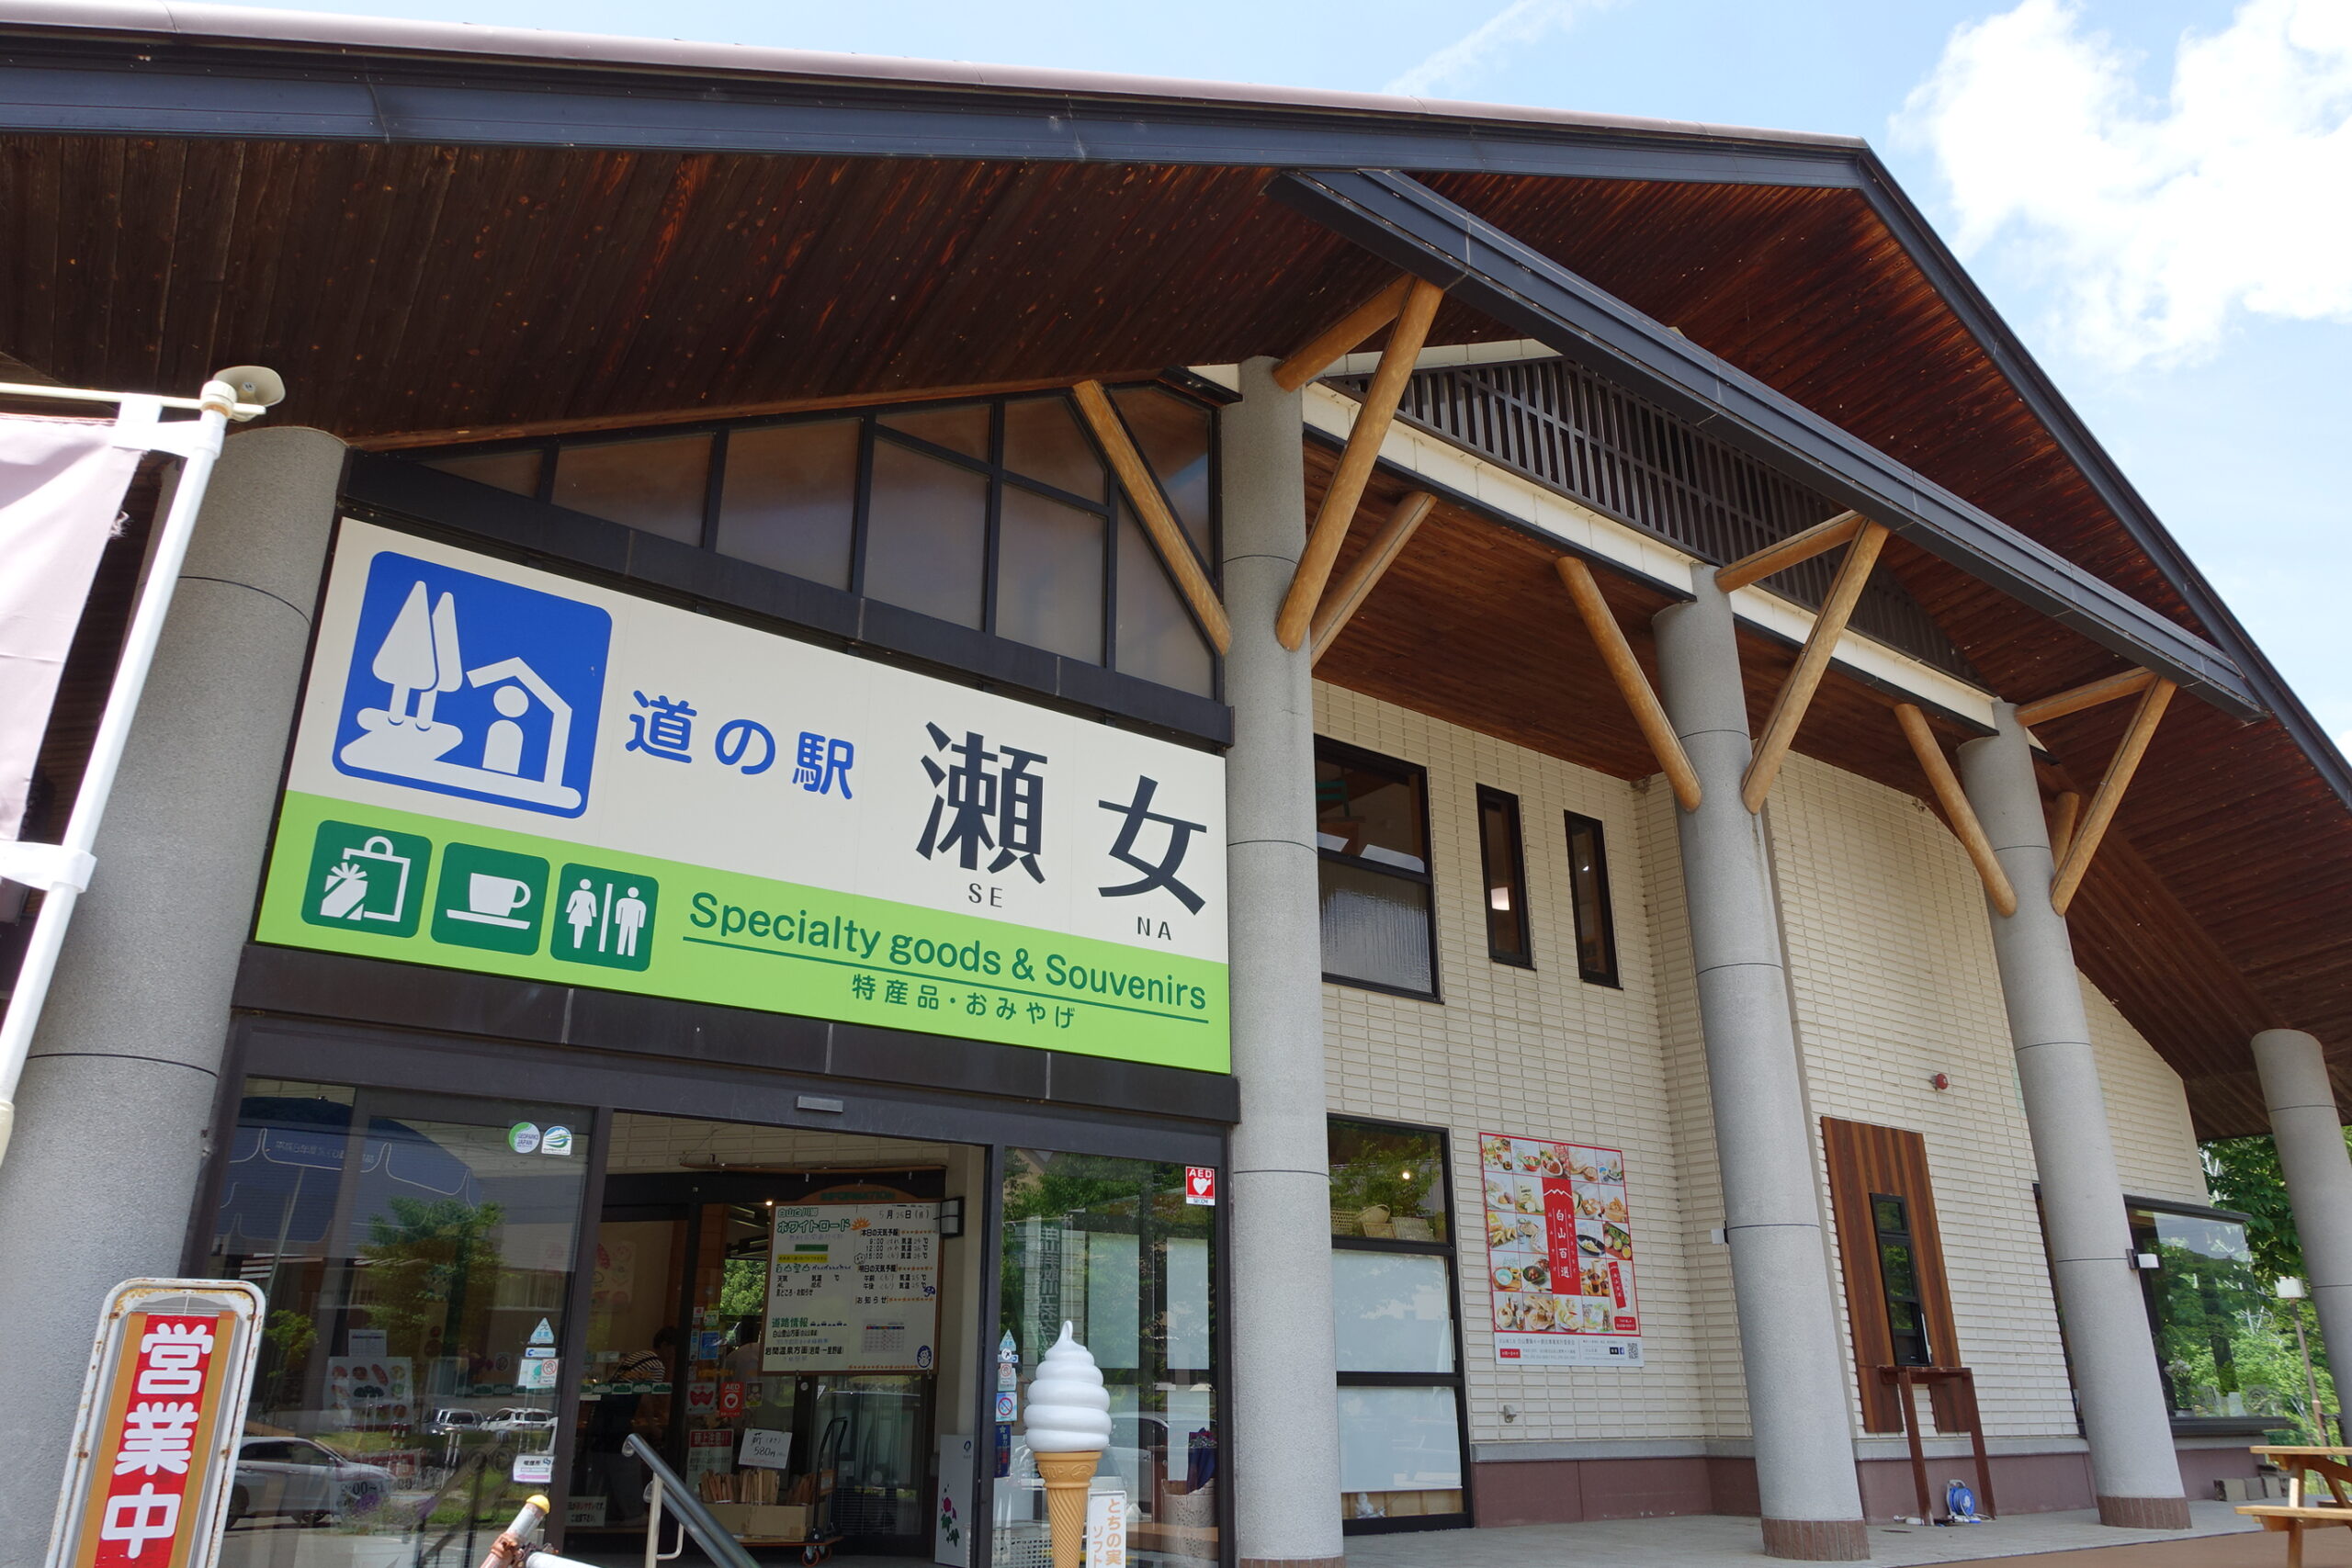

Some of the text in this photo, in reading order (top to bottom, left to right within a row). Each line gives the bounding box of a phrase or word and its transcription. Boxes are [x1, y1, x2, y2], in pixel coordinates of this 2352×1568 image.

[625, 690, 854, 800] 道の駅
[915, 720, 1208, 916] 瀬女
[967, 882, 1003, 908] SE
[690, 891, 1206, 1010] Specialty goods & Souvenirs
[1136, 917, 1172, 942] NA
[852, 974, 1075, 1030] 特産品・おみやげ
[1189, 1168, 1212, 1178] AED
[777, 1218, 851, 1234] ホワイトロード
[772, 1317, 808, 1328] 道路情報
[101, 1323, 214, 1560] 営業中
[1092, 1526, 1102, 1568] ソフト
[1105, 1498, 1122, 1565] とちの実
